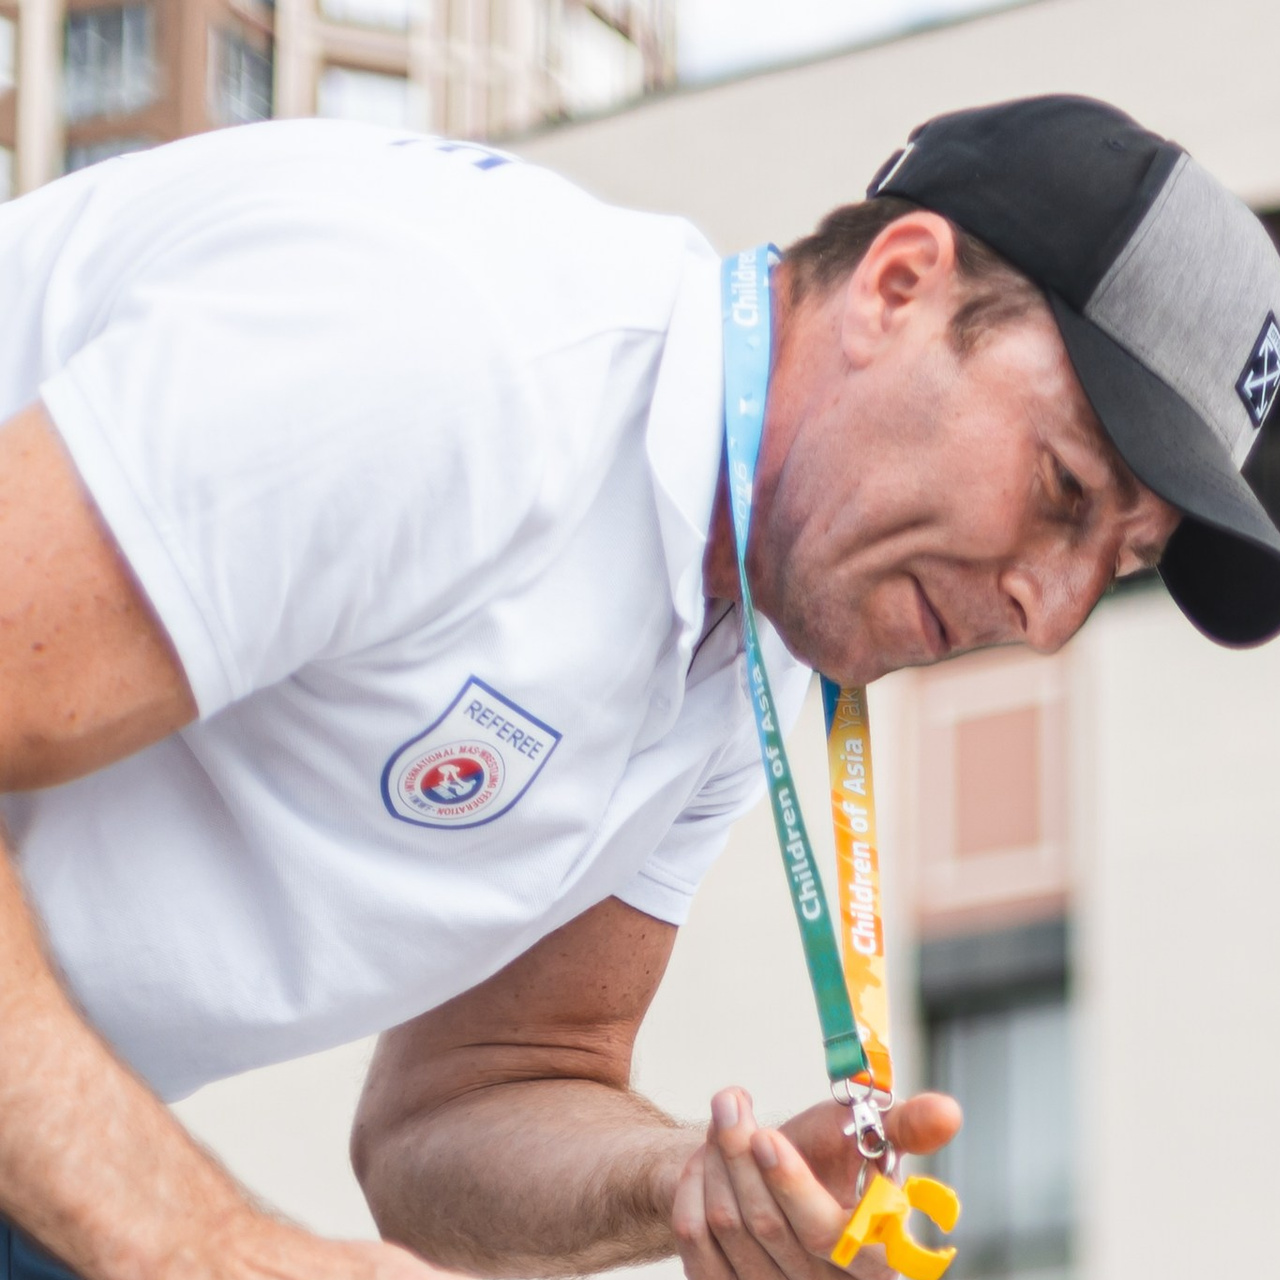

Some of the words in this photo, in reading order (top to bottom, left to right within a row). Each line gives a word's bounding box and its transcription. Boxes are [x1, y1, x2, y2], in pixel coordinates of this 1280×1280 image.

[731, 250, 759, 327] Childre
[463, 699, 544, 760] REFEREE
[752, 663, 775, 732] Asia
[834, 689, 862, 730] Yak
[405, 748, 455, 792] INTERNATIONAL
[437, 790, 492, 816] FEDERATION
[765, 746, 784, 778] of
[840, 738, 866, 795] Asia
[842, 800, 869, 834] of
[778, 787, 821, 921] Children
[848, 843, 877, 955] Children
